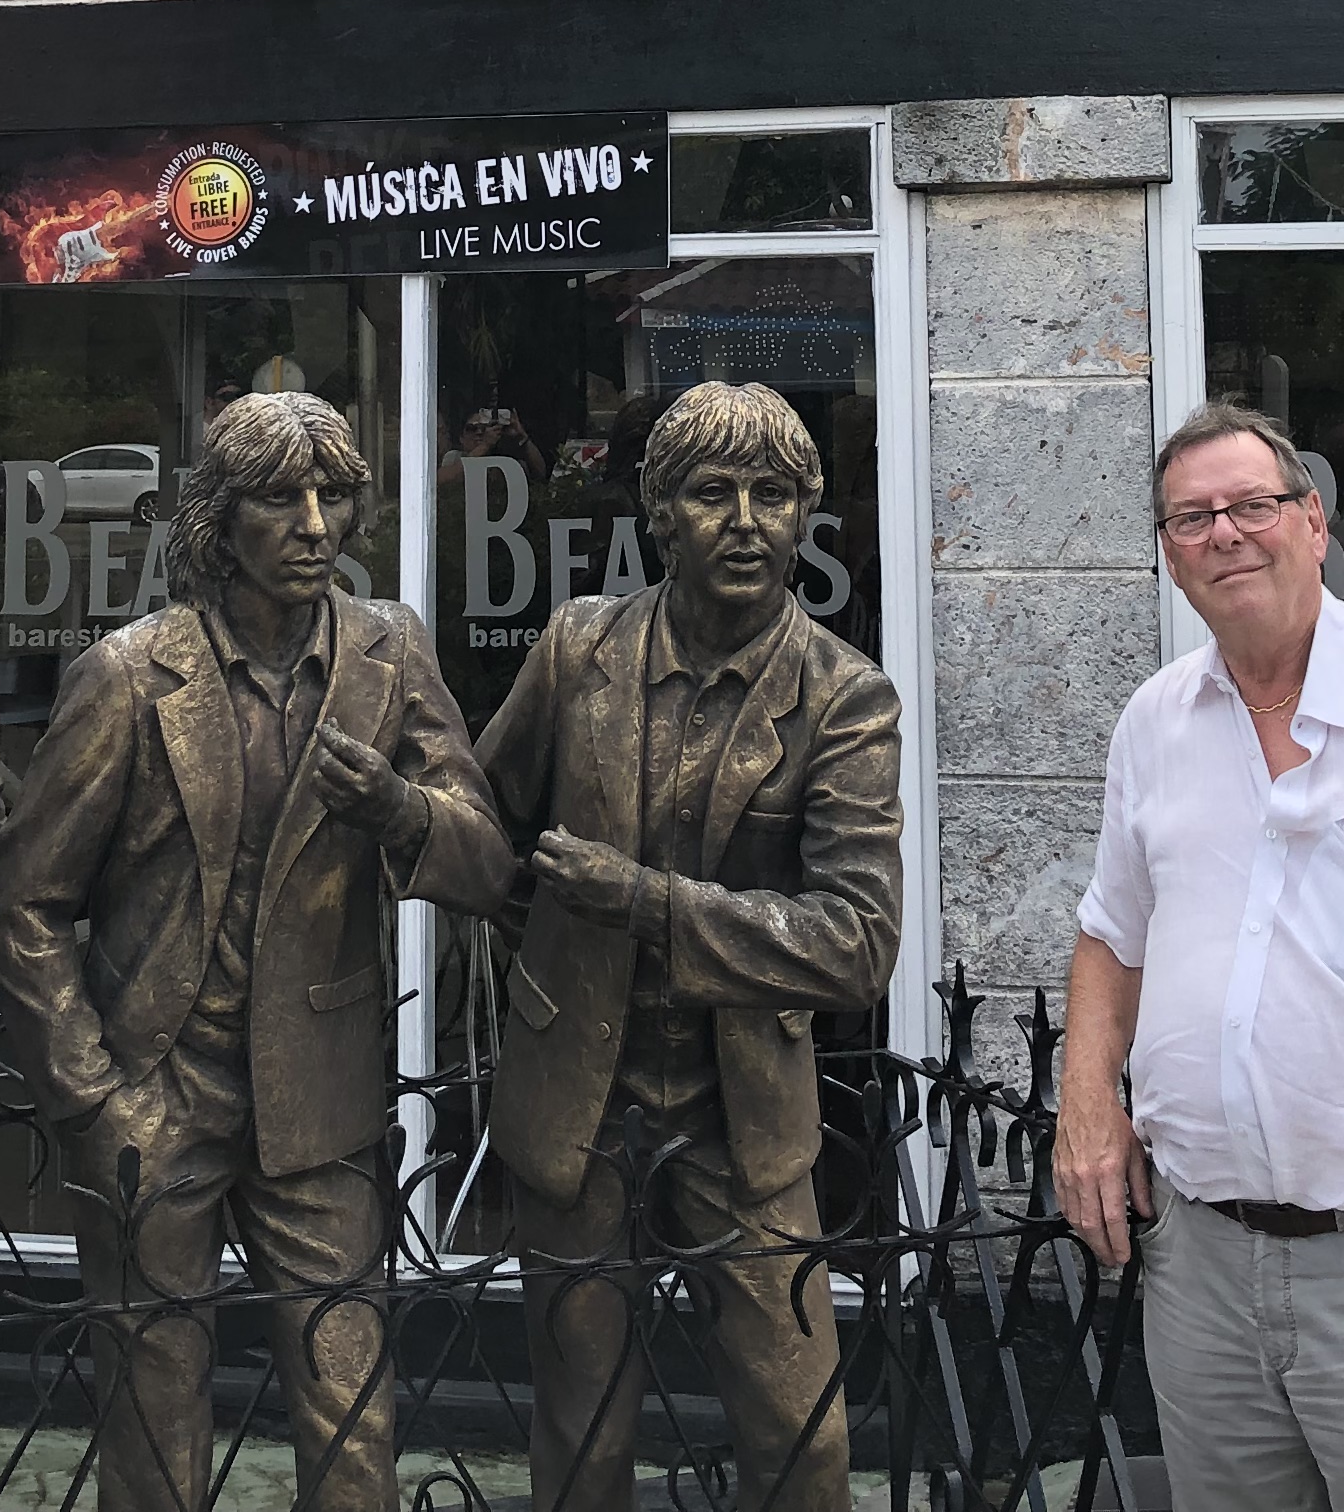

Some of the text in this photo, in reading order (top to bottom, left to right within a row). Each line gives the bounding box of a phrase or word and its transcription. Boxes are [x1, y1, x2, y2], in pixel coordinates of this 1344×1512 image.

[189, 172, 220, 185] Entrada
[197, 180, 230, 197] LIBRE
[324, 145, 622, 224] MÚSICA EN VIVO
[166, 207, 269, 263] LIVE COVER BANDS
[420, 218, 601, 259] LIVE MUSIC
